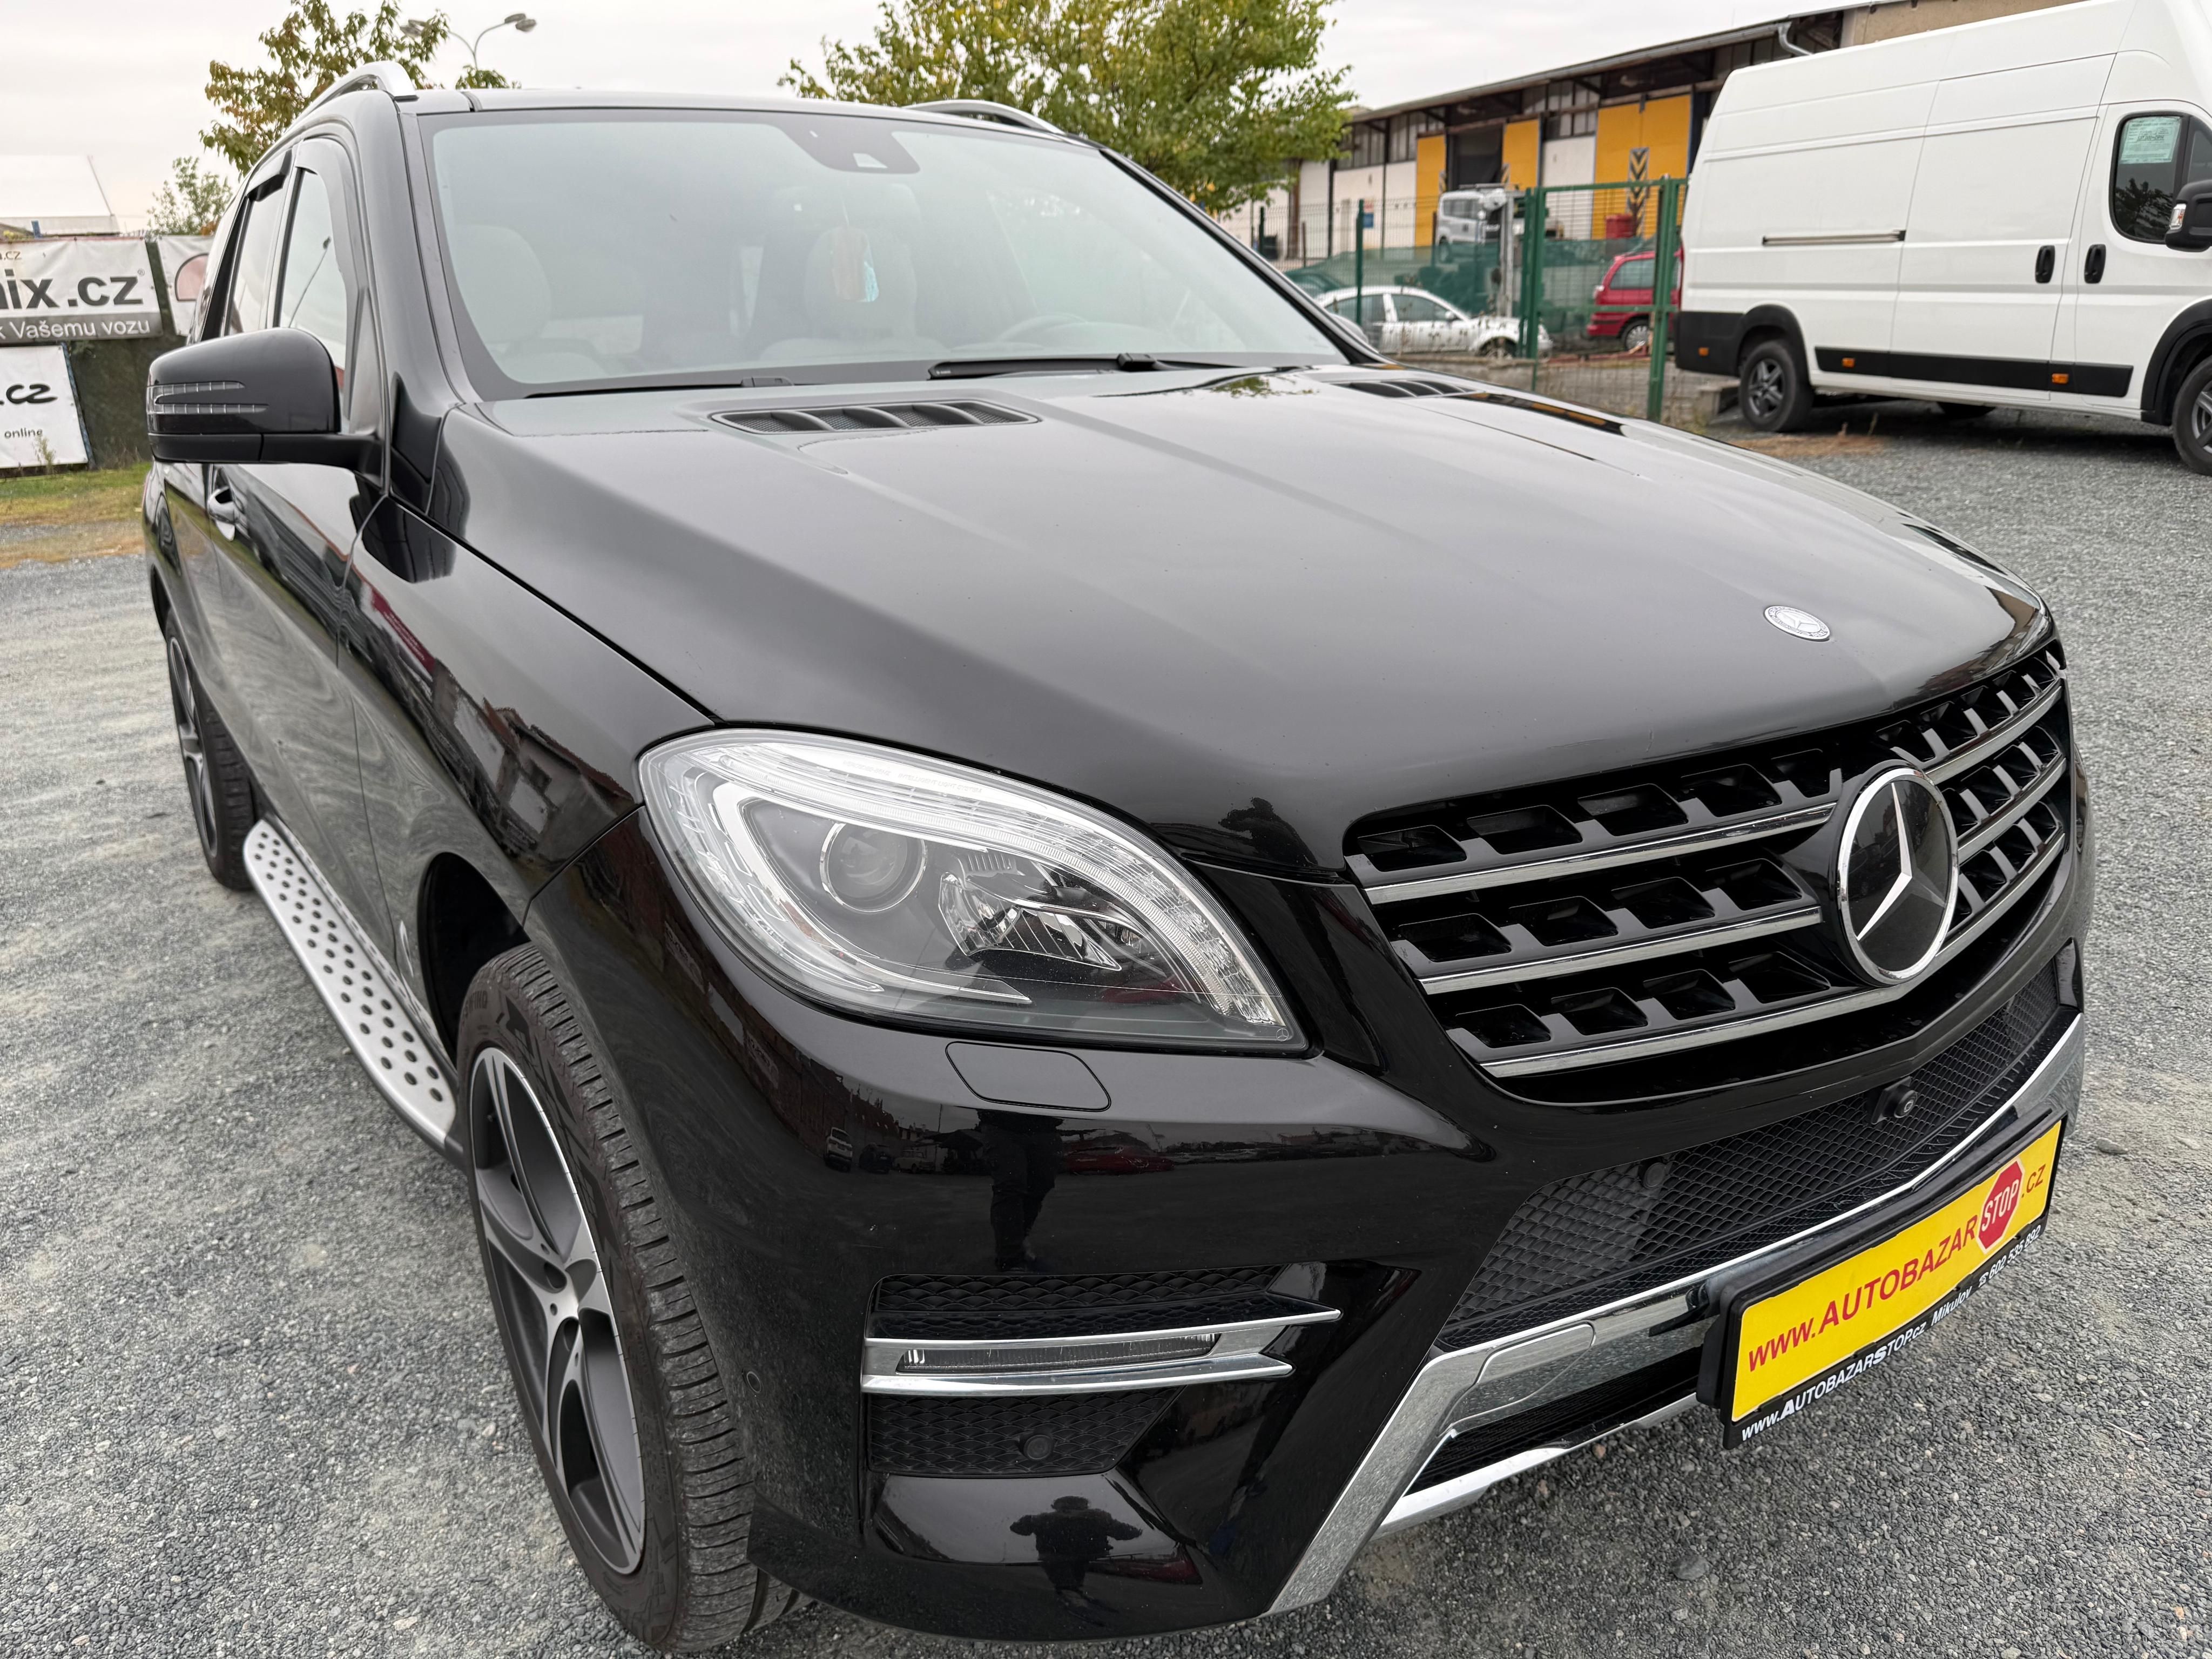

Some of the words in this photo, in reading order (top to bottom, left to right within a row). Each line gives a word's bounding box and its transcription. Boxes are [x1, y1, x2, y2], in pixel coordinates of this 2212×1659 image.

[9, 320, 96, 339] Vašemu
[102, 320, 151, 335] vozu
[4, 427, 43, 439] online
[1931, 1286, 1972, 1326] Mikulov
[1988, 1255, 2007, 1279] 602
[2007, 1239, 2025, 1264] 535
[2024, 1224, 2041, 1248] 892
